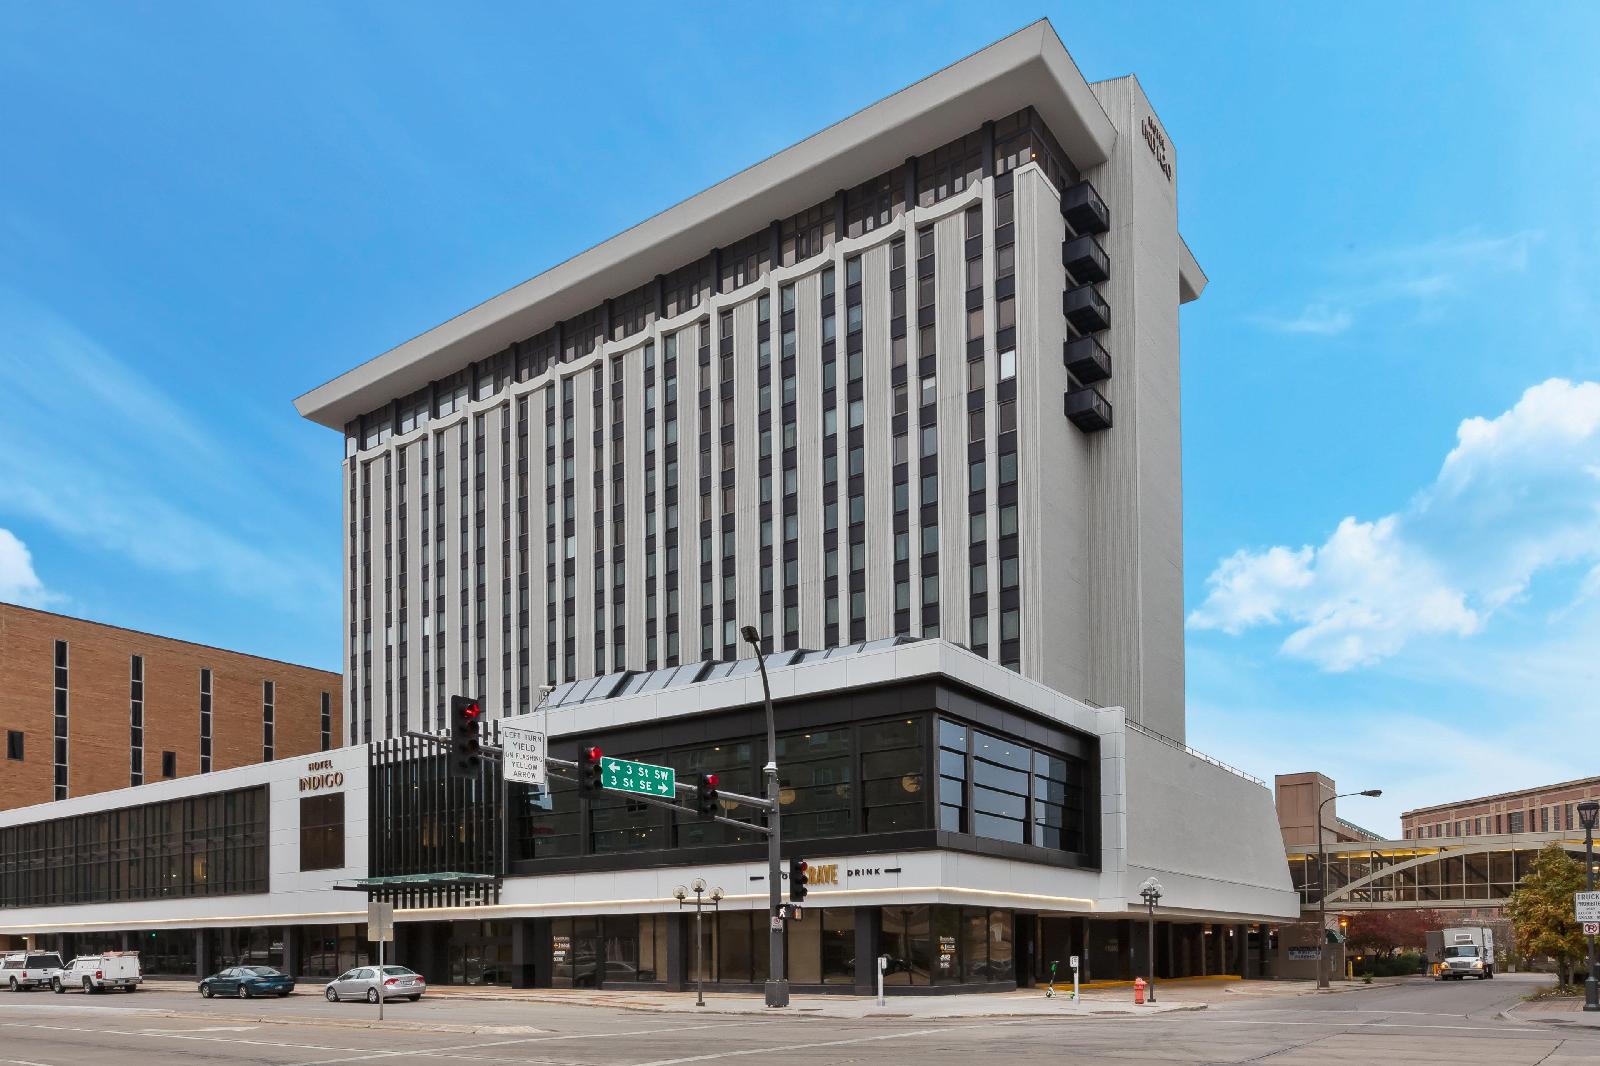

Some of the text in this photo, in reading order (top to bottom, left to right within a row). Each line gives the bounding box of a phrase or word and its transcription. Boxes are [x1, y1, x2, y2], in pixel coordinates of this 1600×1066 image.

[504, 731, 542, 742] LEFT TURN
[512, 741, 536, 752] YIELD
[515, 752, 543, 763] FLASHING
[308, 760, 333, 771] HOTEL
[511, 761, 538, 771] YELLOW
[513, 769, 536, 779] ARROW
[626, 765, 669, 781] 3 St SW
[298, 772, 344, 792] INDIGO
[611, 775, 653, 791] 3 St SE
[807, 864, 839, 886] RAVE
[847, 867, 881, 877] DRINK
